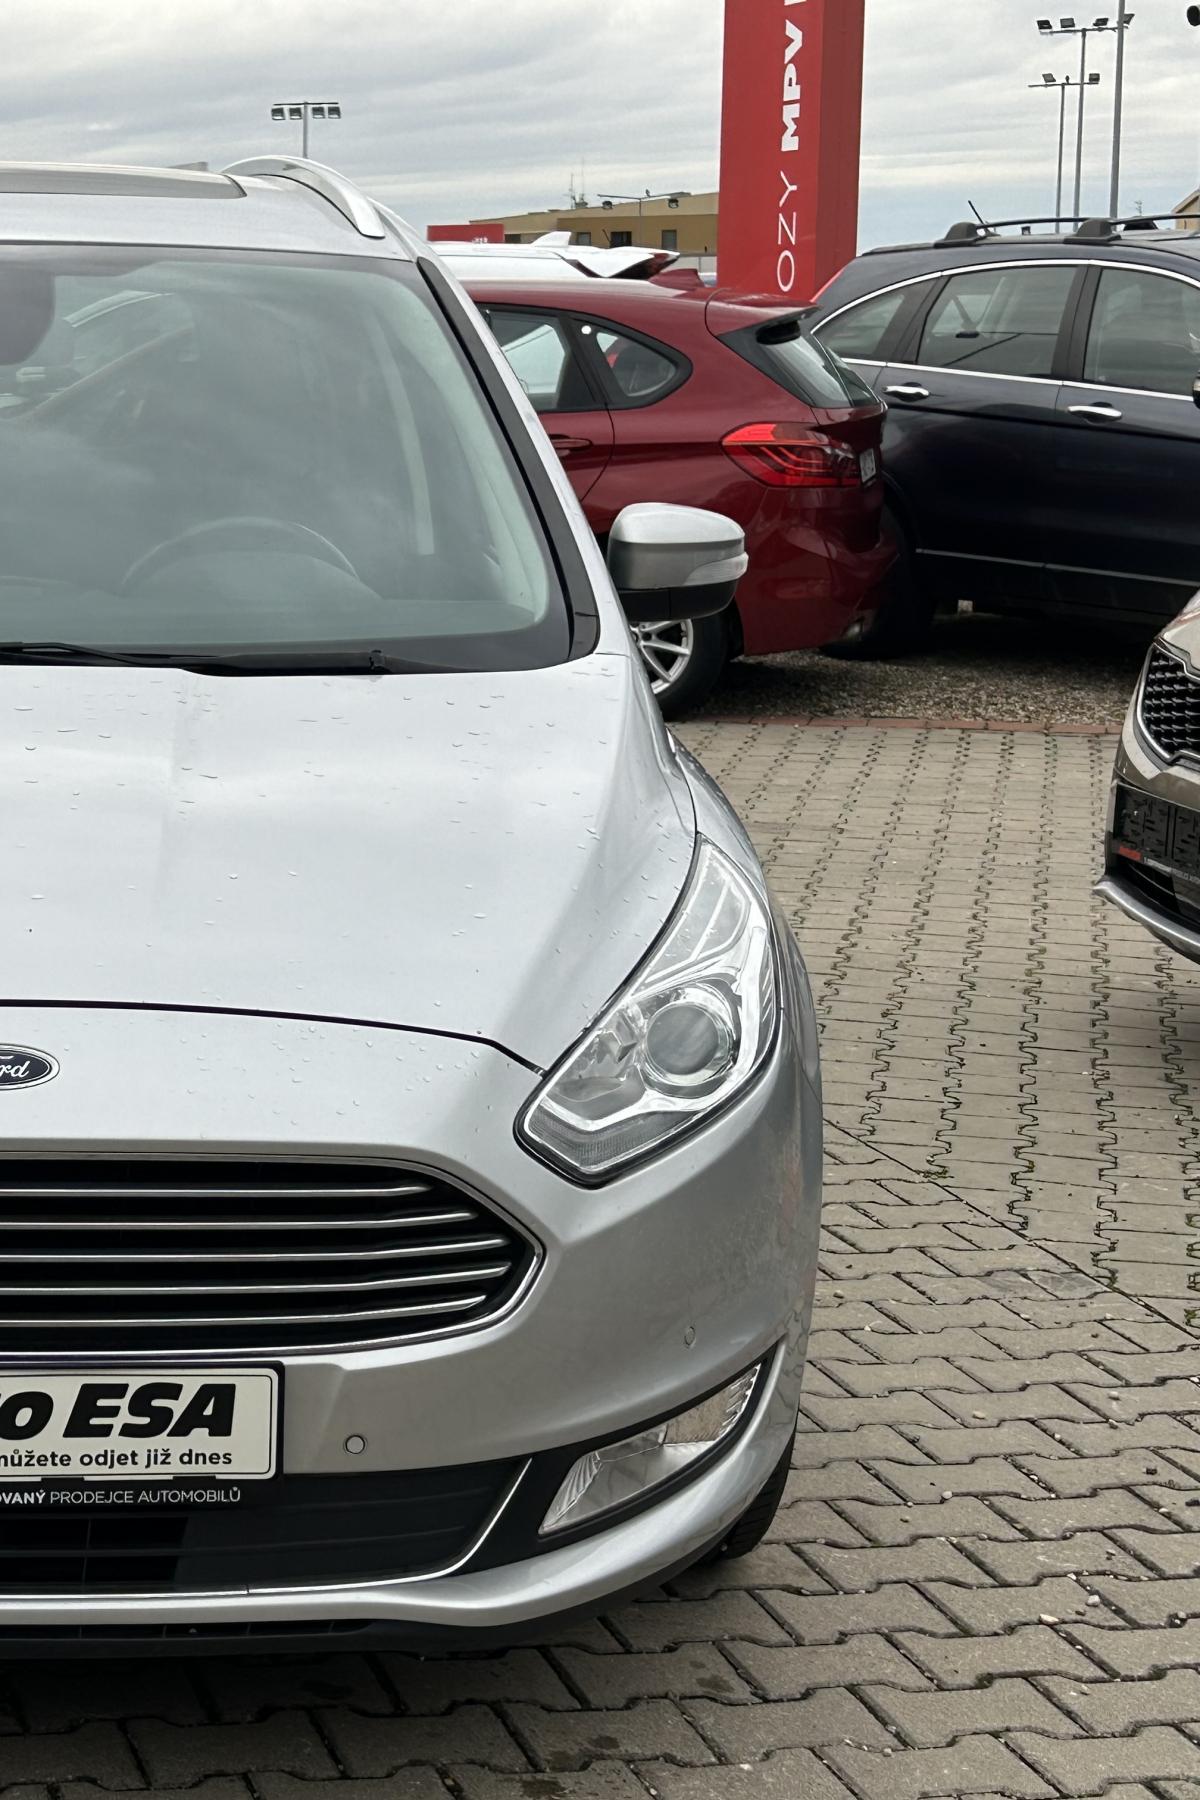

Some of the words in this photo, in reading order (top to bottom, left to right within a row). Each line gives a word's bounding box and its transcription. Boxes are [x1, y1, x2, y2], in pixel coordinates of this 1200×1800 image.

[781, 19, 803, 152] MPV
[777, 170, 797, 292] OZY
[62, 1382, 236, 1439] ESA
[79, 1450, 139, 1469] odjet
[145, 1448, 172, 1469] již
[178, 1449, 233, 1466] dnes
[50, 1491, 134, 1504] PRODEJCE
[137, 1486, 241, 1504] AUTOMOBILŮ
